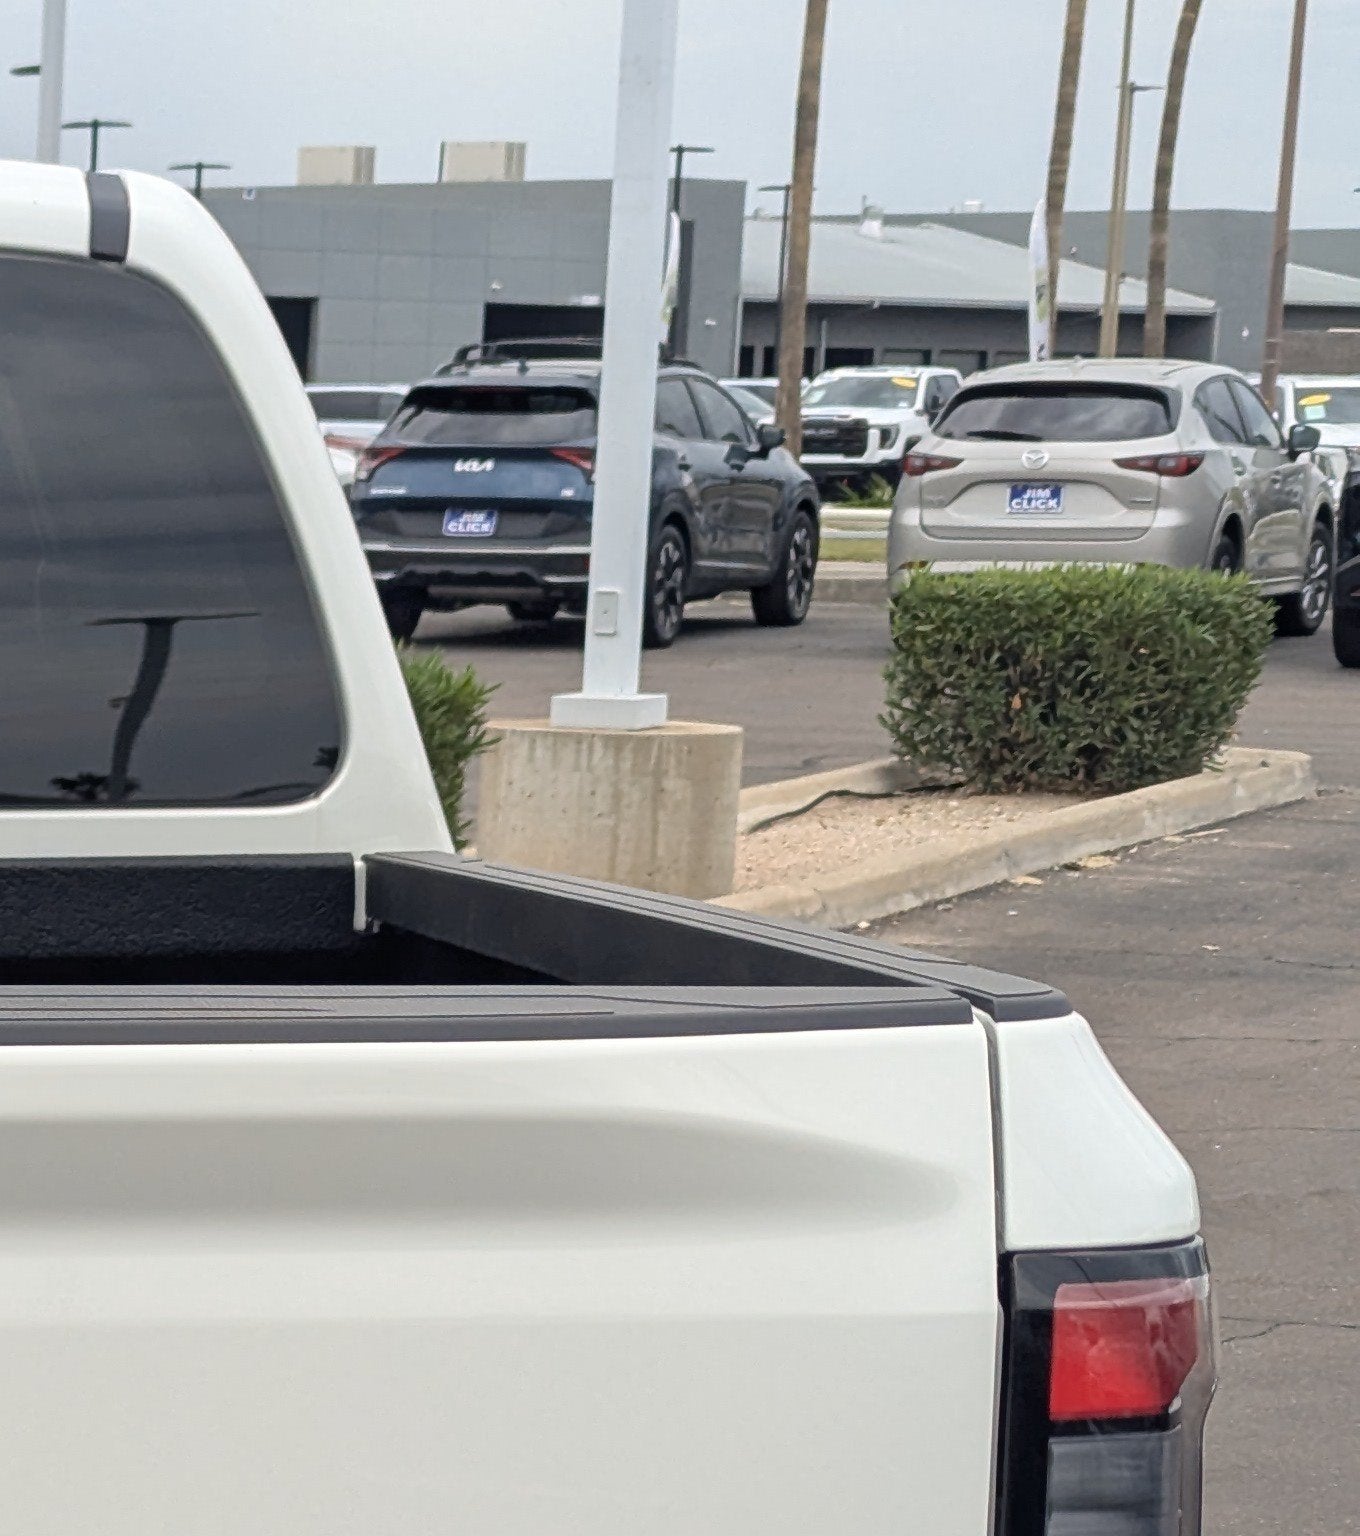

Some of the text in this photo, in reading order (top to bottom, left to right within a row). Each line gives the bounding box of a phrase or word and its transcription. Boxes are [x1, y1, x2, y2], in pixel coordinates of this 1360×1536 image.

[1022, 488, 1051, 498] JIM
[1012, 499, 1060, 509] CLICK
[460, 511, 487, 522] JIM
[448, 521, 492, 532] CLICK
